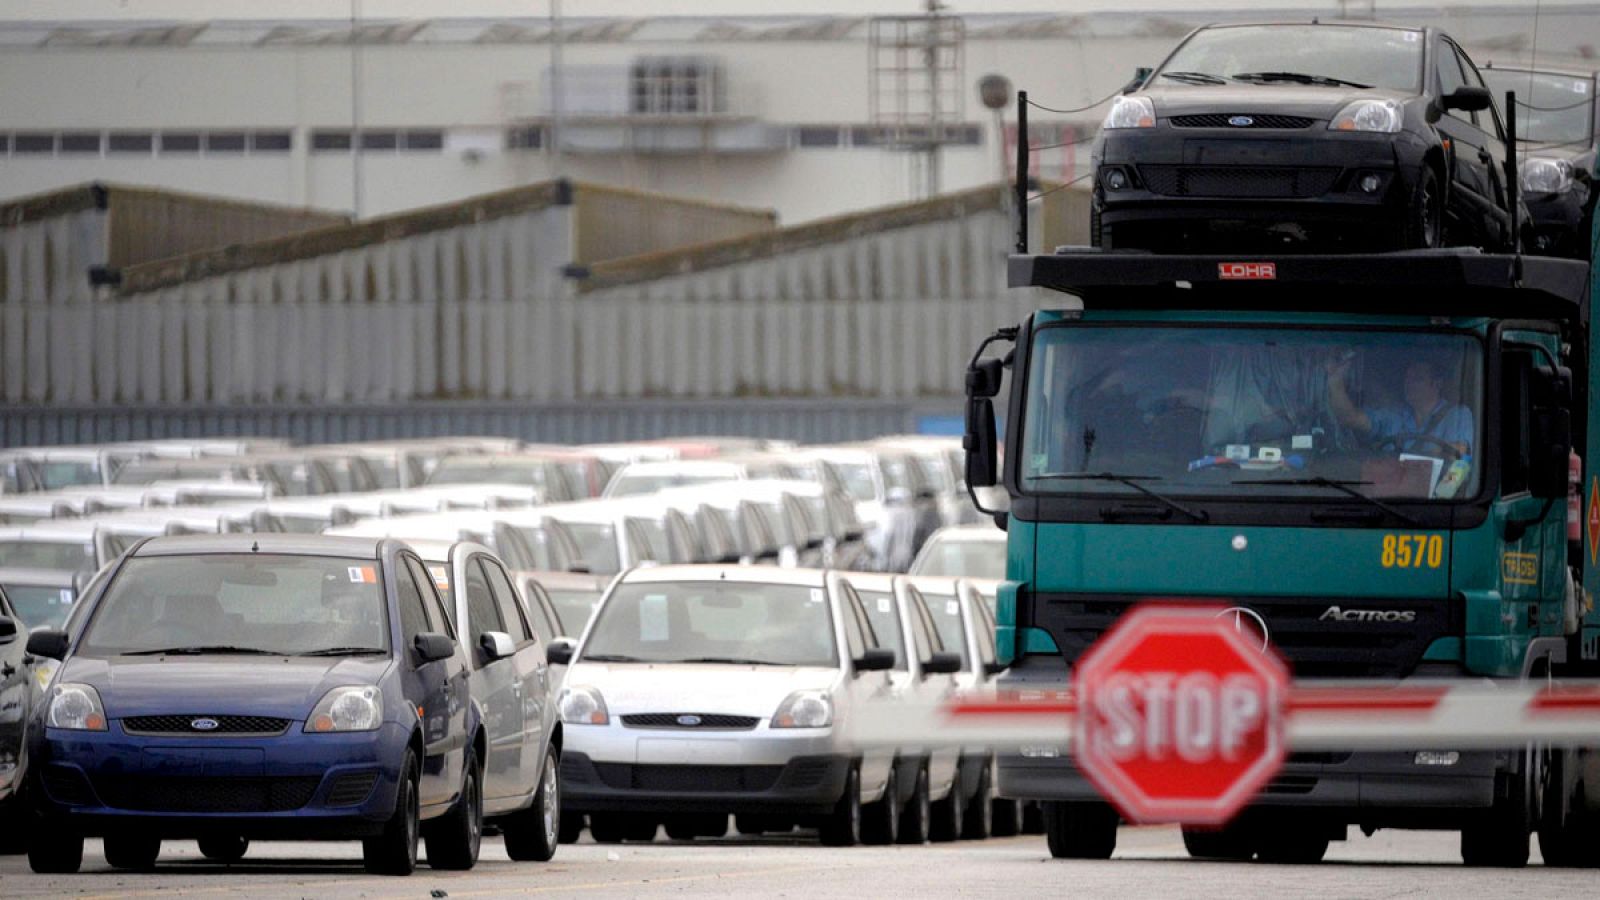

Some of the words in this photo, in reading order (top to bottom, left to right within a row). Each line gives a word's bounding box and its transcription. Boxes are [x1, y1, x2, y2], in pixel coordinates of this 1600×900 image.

[1221, 263, 1274, 278] LOHR
[1381, 534, 1443, 568] 8570
[1098, 669, 1262, 763] STOP
